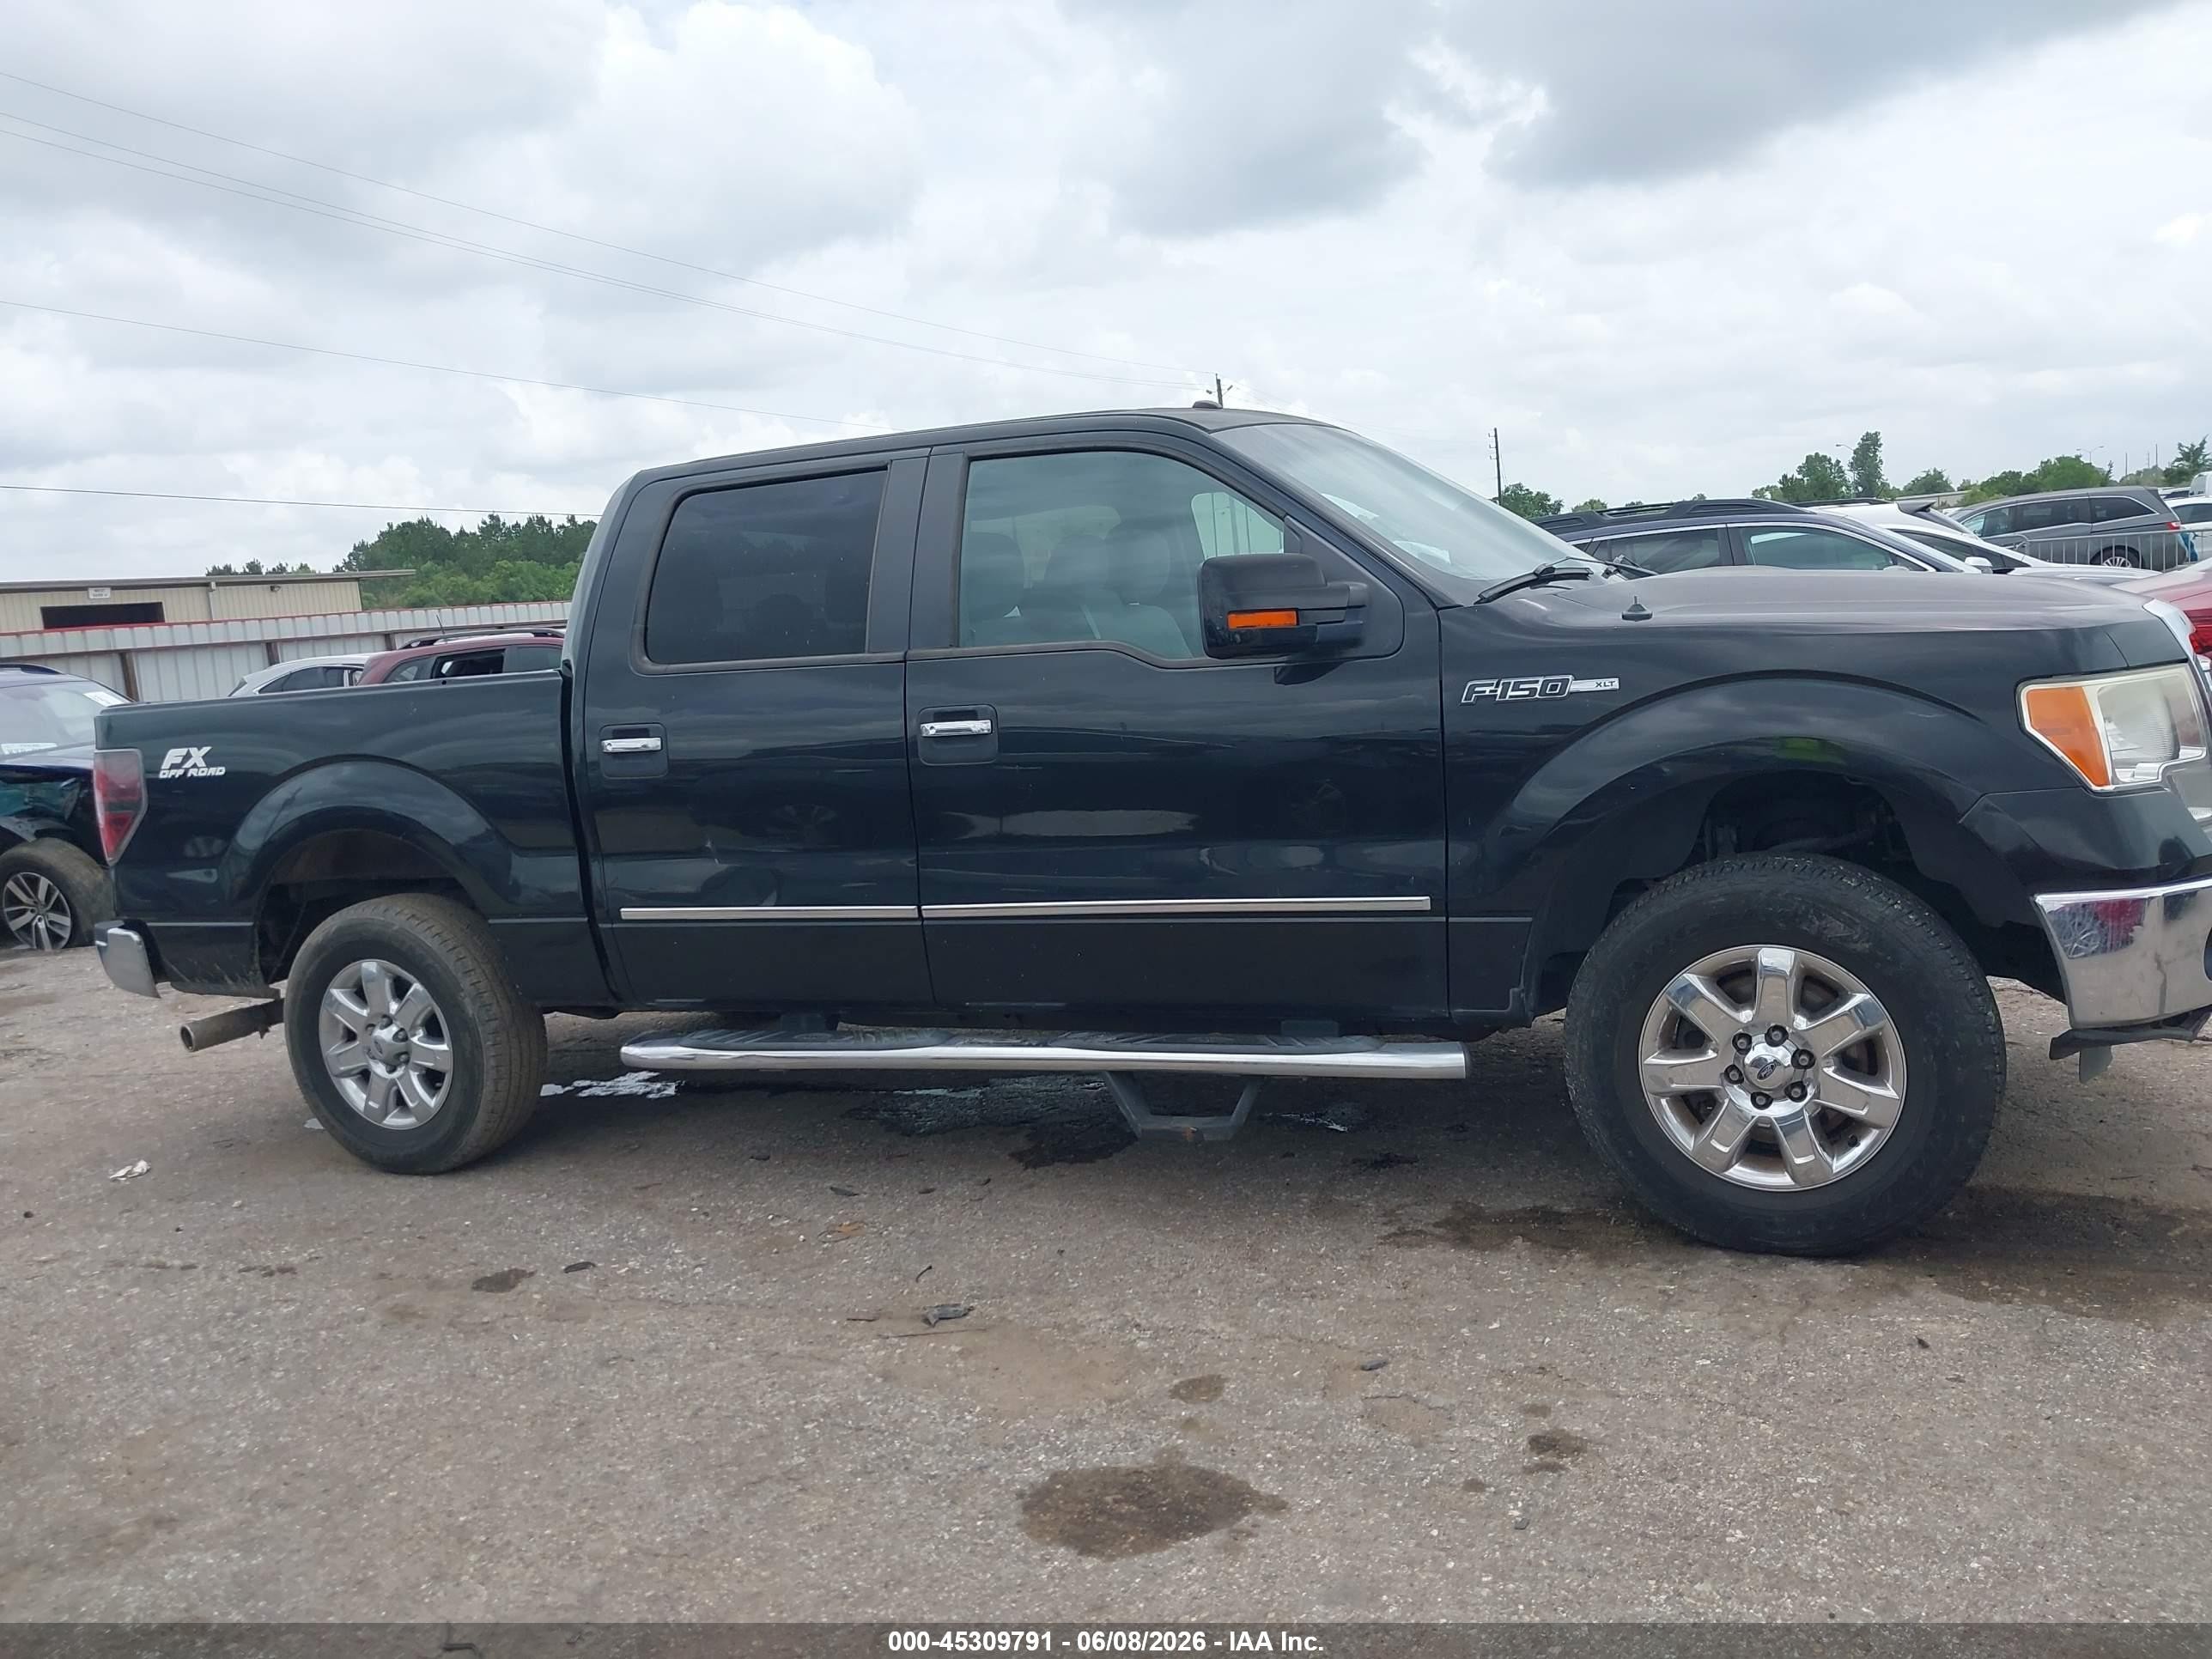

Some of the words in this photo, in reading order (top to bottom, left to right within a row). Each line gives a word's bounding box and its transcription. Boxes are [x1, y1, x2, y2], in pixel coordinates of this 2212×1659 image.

[1460, 674, 1575, 704] F-150
[161, 745, 213, 769] FX
[158, 769, 185, 779] OFF
[186, 766, 227, 777] ROAD
